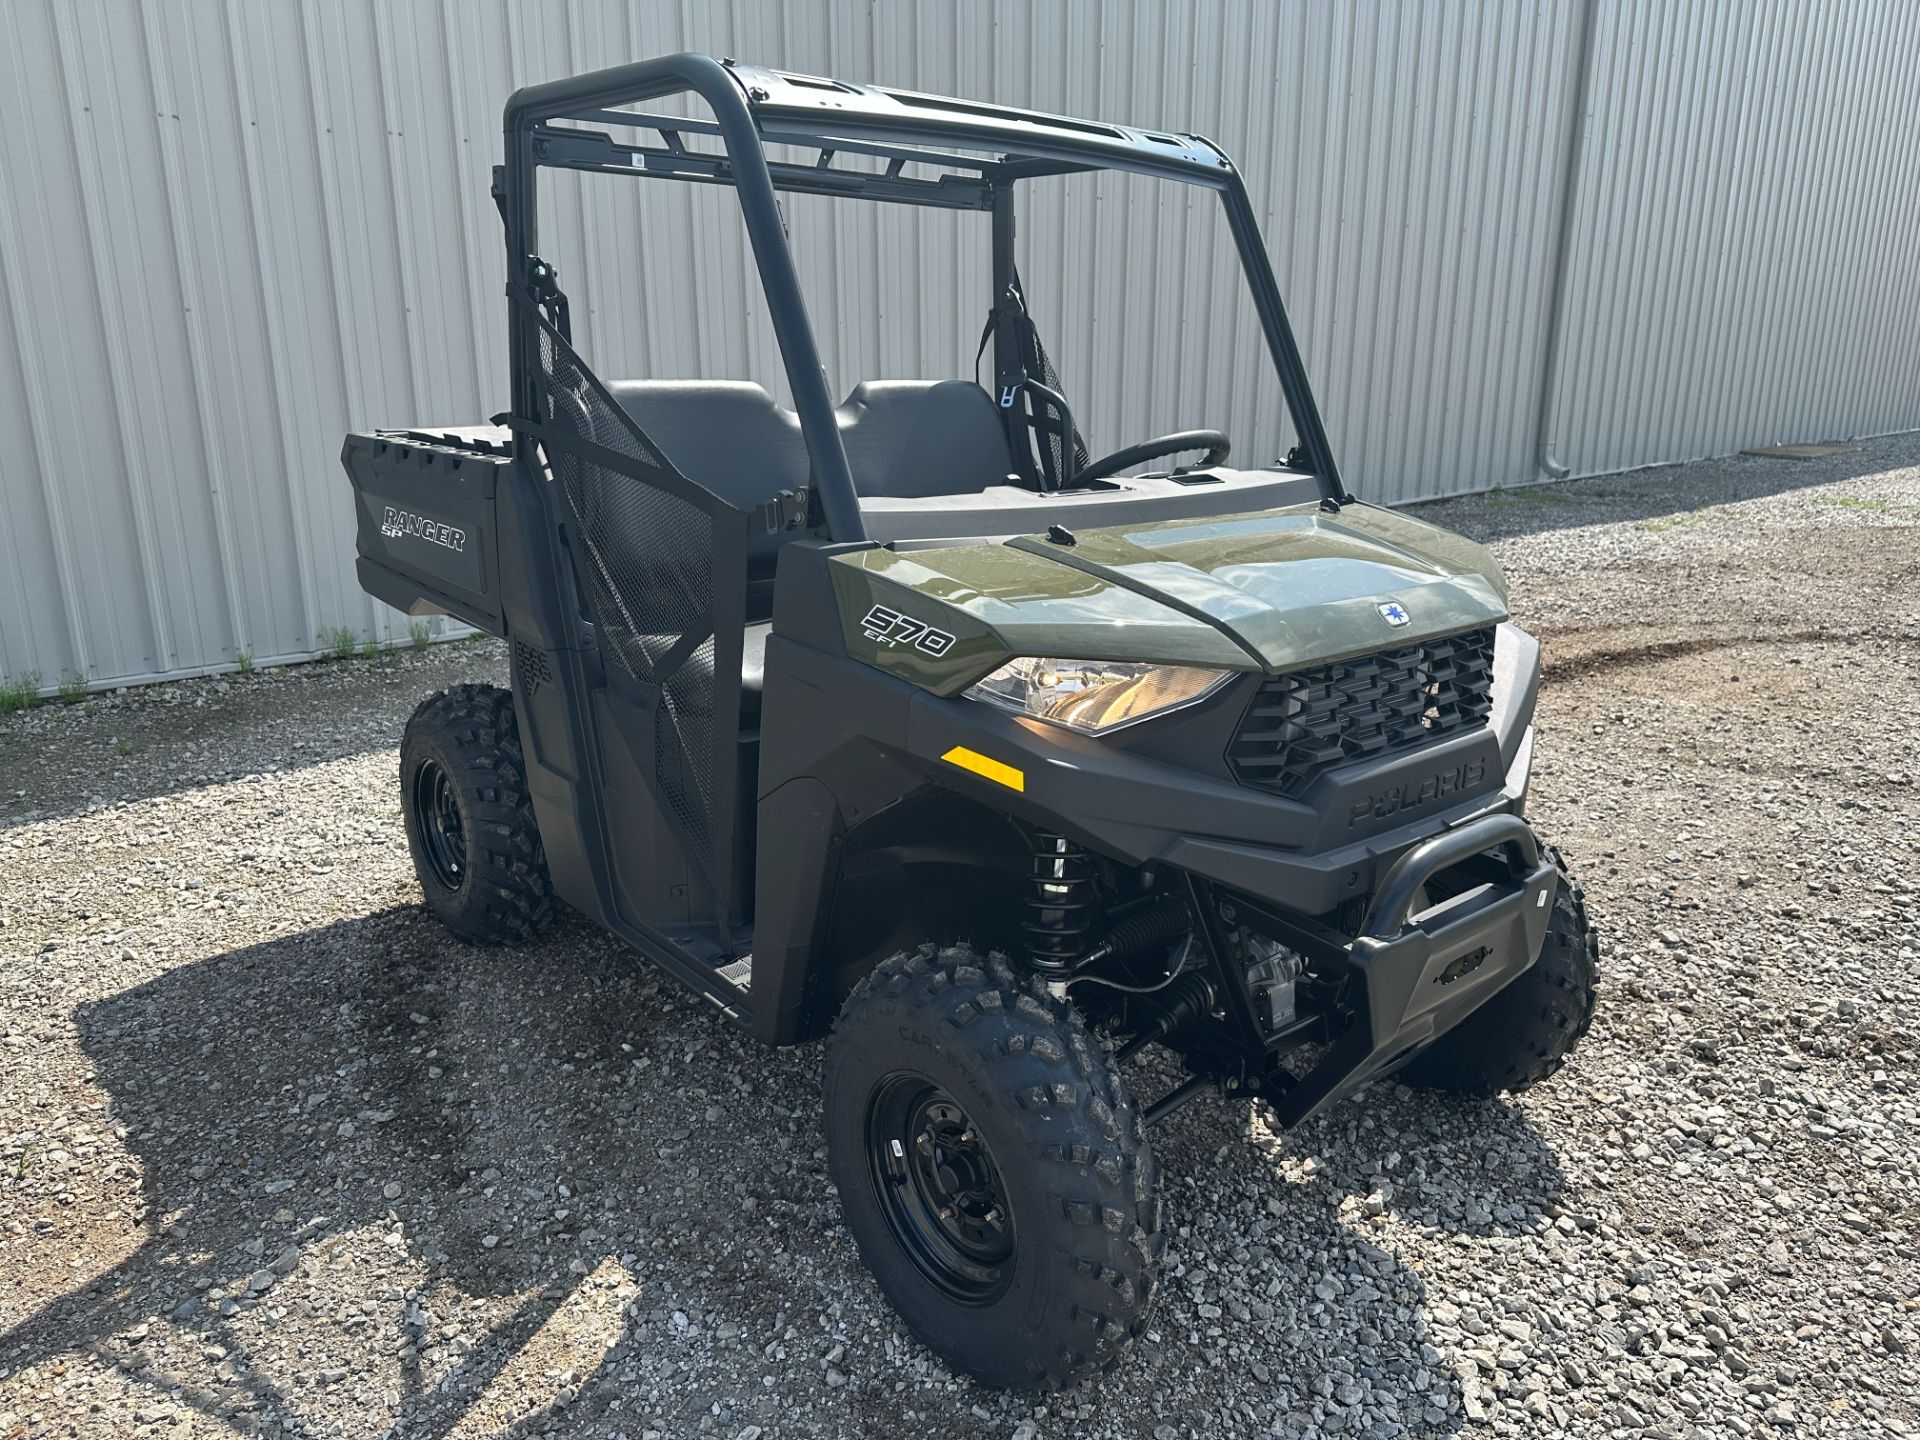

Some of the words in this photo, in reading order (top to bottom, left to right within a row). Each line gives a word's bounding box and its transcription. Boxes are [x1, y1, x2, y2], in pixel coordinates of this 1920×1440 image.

[381, 524, 403, 538] SP
[383, 506, 466, 552] RANGER
[860, 604, 957, 657] 570
[863, 629, 897, 648] EFI
[1348, 757, 1486, 829] POLARIS
